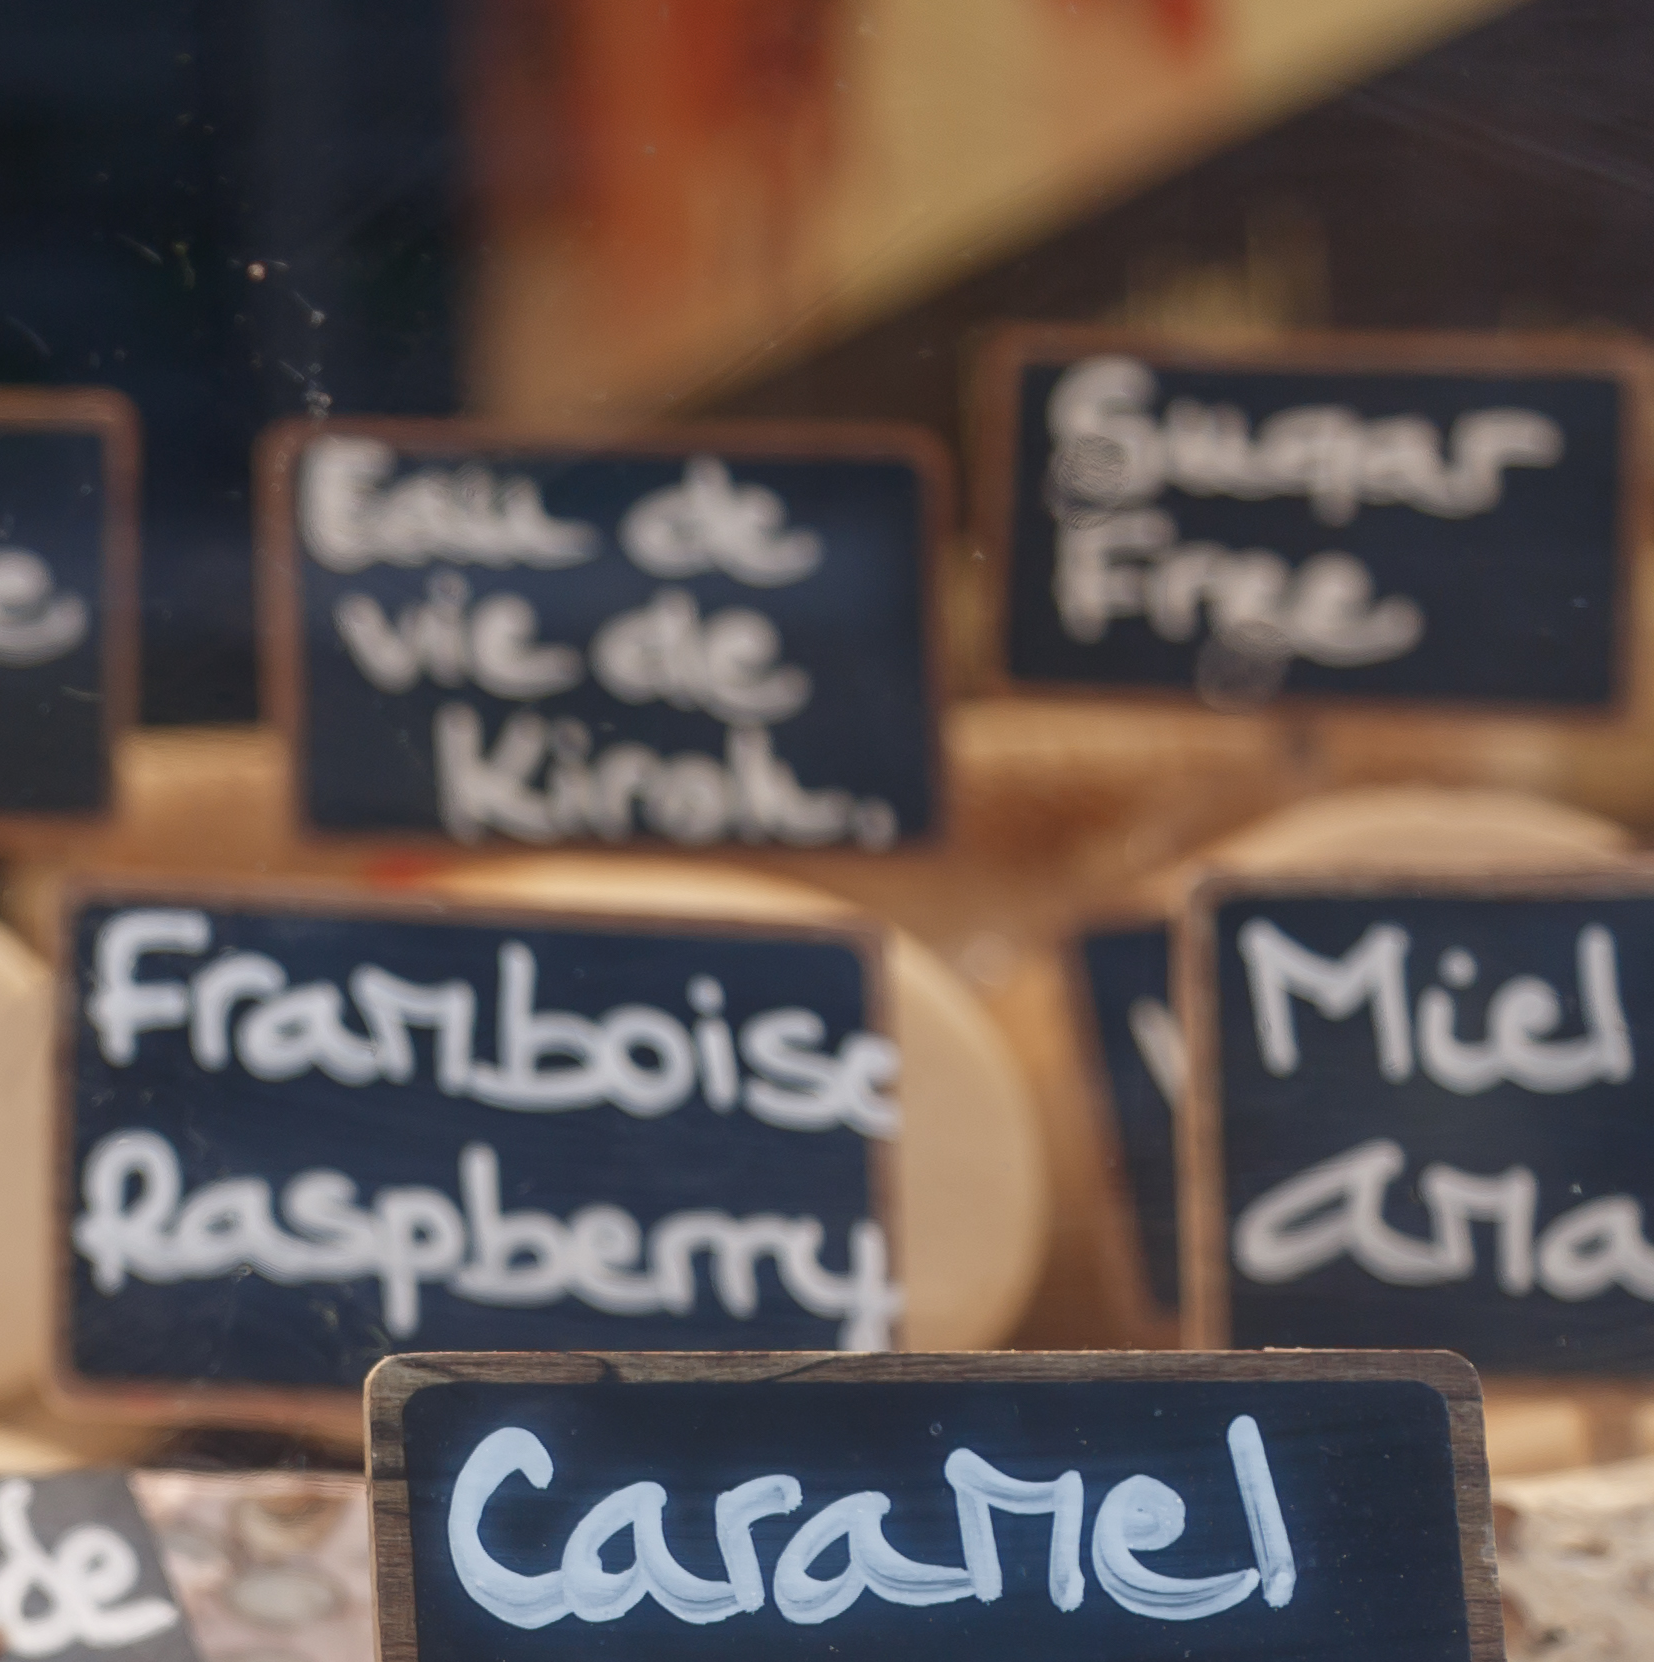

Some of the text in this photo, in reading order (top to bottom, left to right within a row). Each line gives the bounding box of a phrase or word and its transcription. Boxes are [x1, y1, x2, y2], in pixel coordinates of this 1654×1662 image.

[299, 436, 824, 587] Eau de
[1046, 354, 1564, 527] Sugar
[334, 570, 811, 725] vie de
[1054, 505, 1424, 667] Free
[87, 906, 903, 1139] Framboise
[1237, 915, 1635, 1096] Miel
[71, 1127, 907, 1352] Raspberry
[447, 1414, 1296, 1630] Caramel
